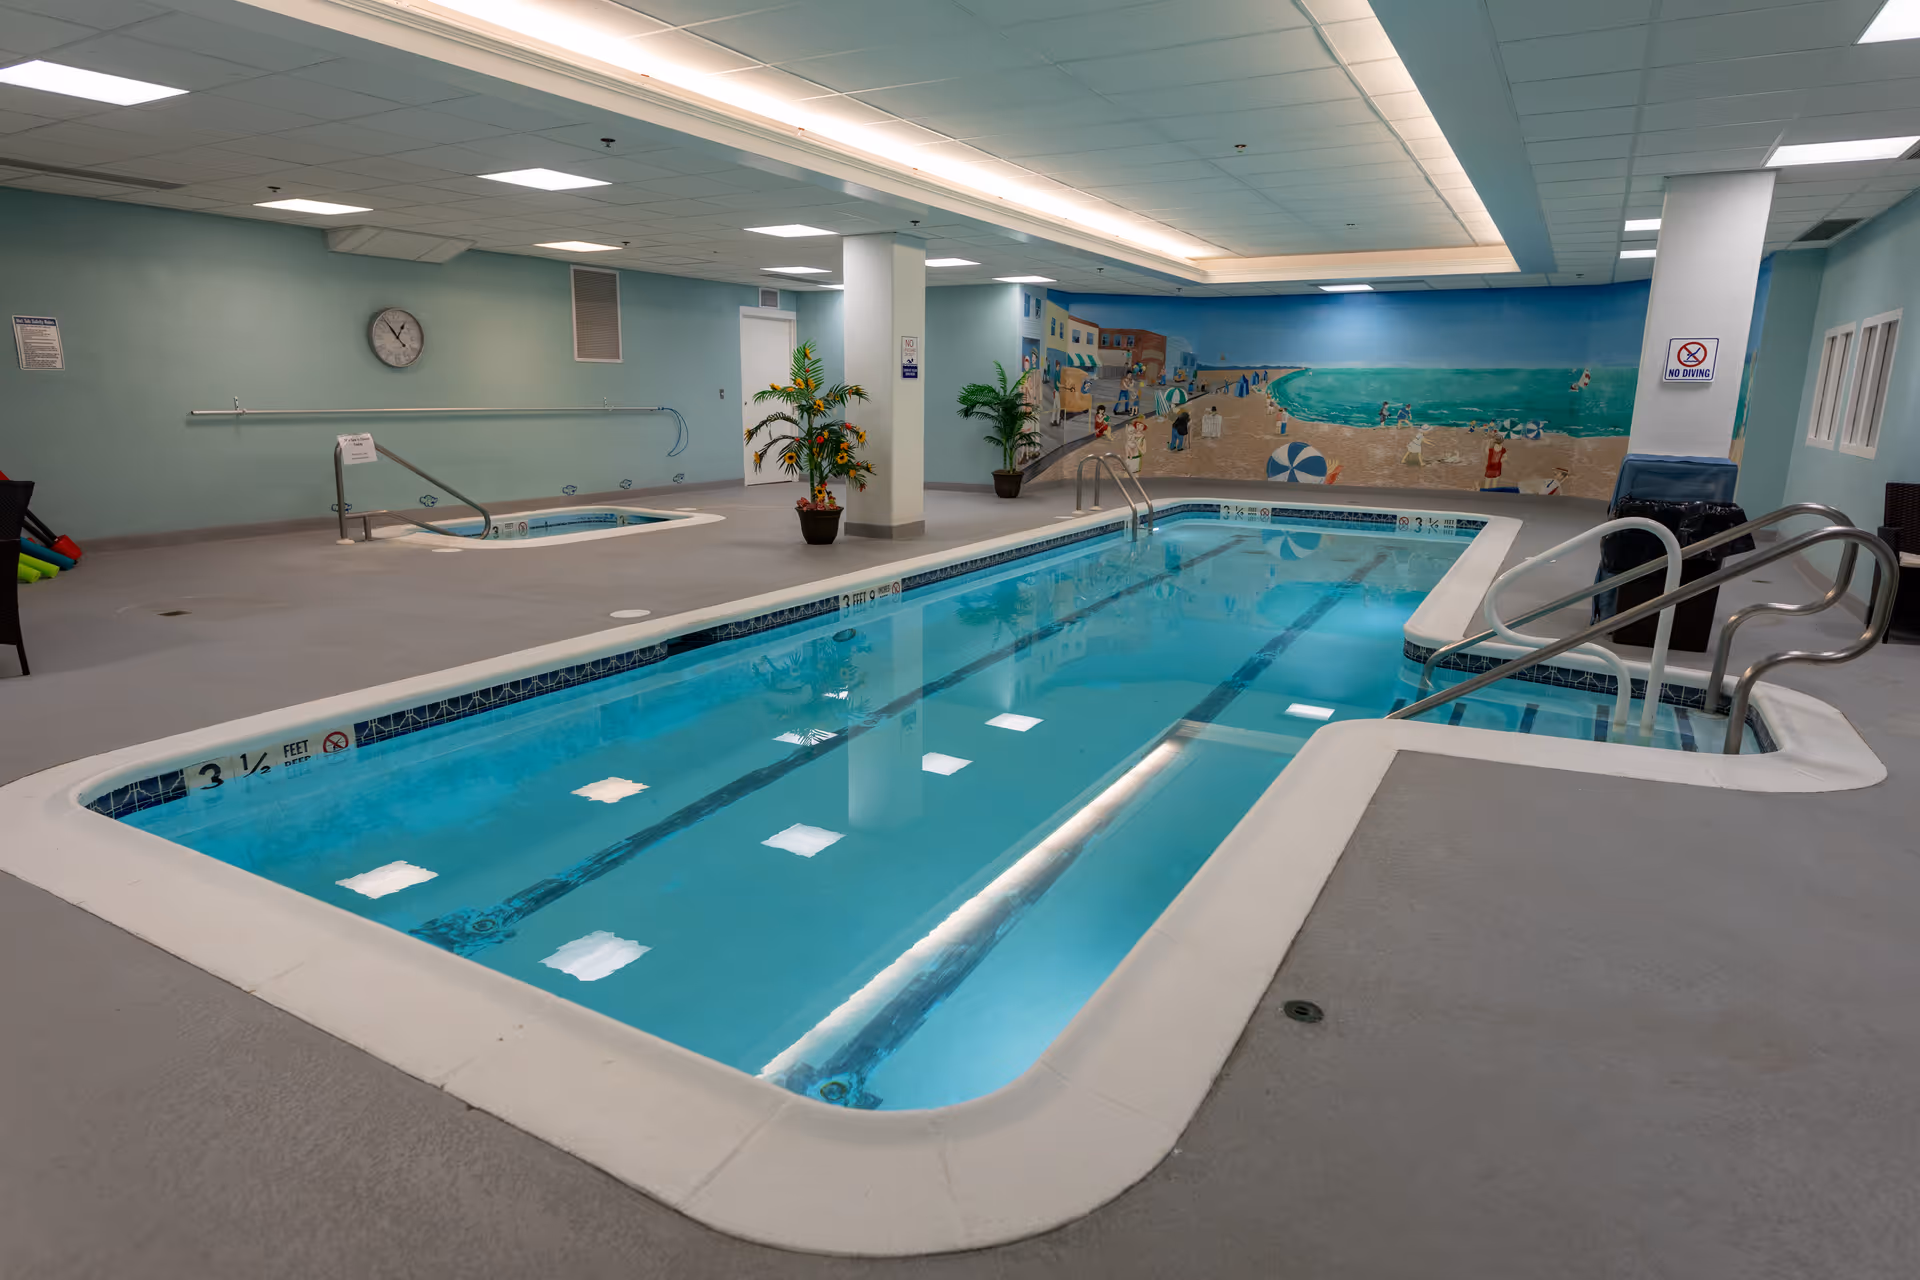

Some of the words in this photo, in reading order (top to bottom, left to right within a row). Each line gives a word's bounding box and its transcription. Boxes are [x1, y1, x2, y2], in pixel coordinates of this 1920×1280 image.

[905, 339, 914, 348] NO
[1668, 368, 1680, 378] NO
[1682, 368, 1710, 378] DIVING
[283, 739, 309, 758] FEET
[198, 763, 224, 790] 3
